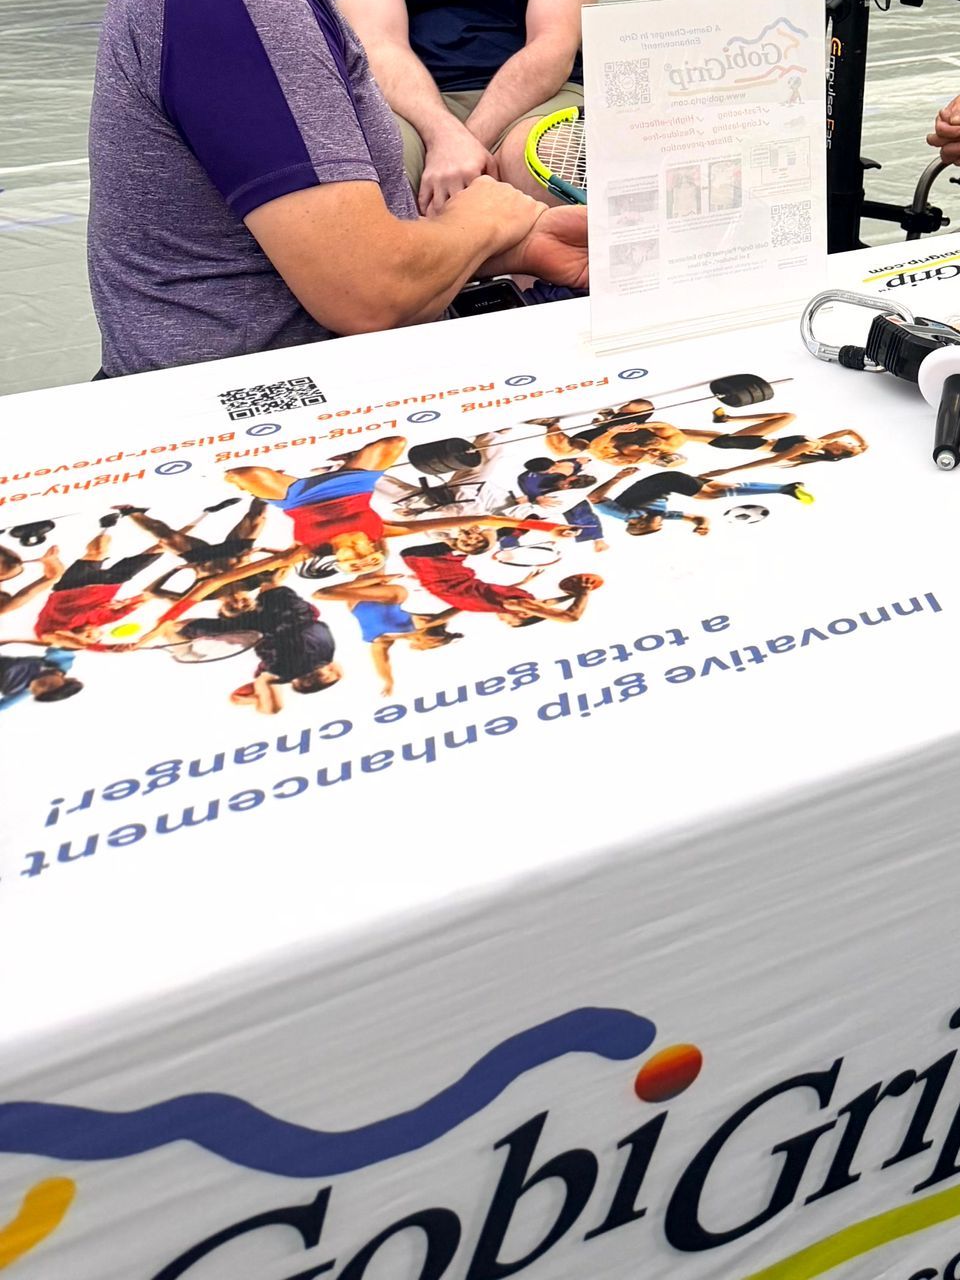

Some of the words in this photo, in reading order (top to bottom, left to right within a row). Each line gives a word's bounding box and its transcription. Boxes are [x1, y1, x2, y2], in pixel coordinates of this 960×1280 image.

[317, 381, 495, 421] Residue-free
[461, 376, 609, 413] Fast-acting
[214, 419, 398, 464] Long-lasting
[665, 592, 943, 684] Innovative
[701, 615, 730, 634] a
[556, 628, 689, 680] total
[373, 660, 541, 724] game
[537, 672, 648, 722] grip
[20, 716, 518, 879] enhancement
[44, 719, 353, 827] changer!
